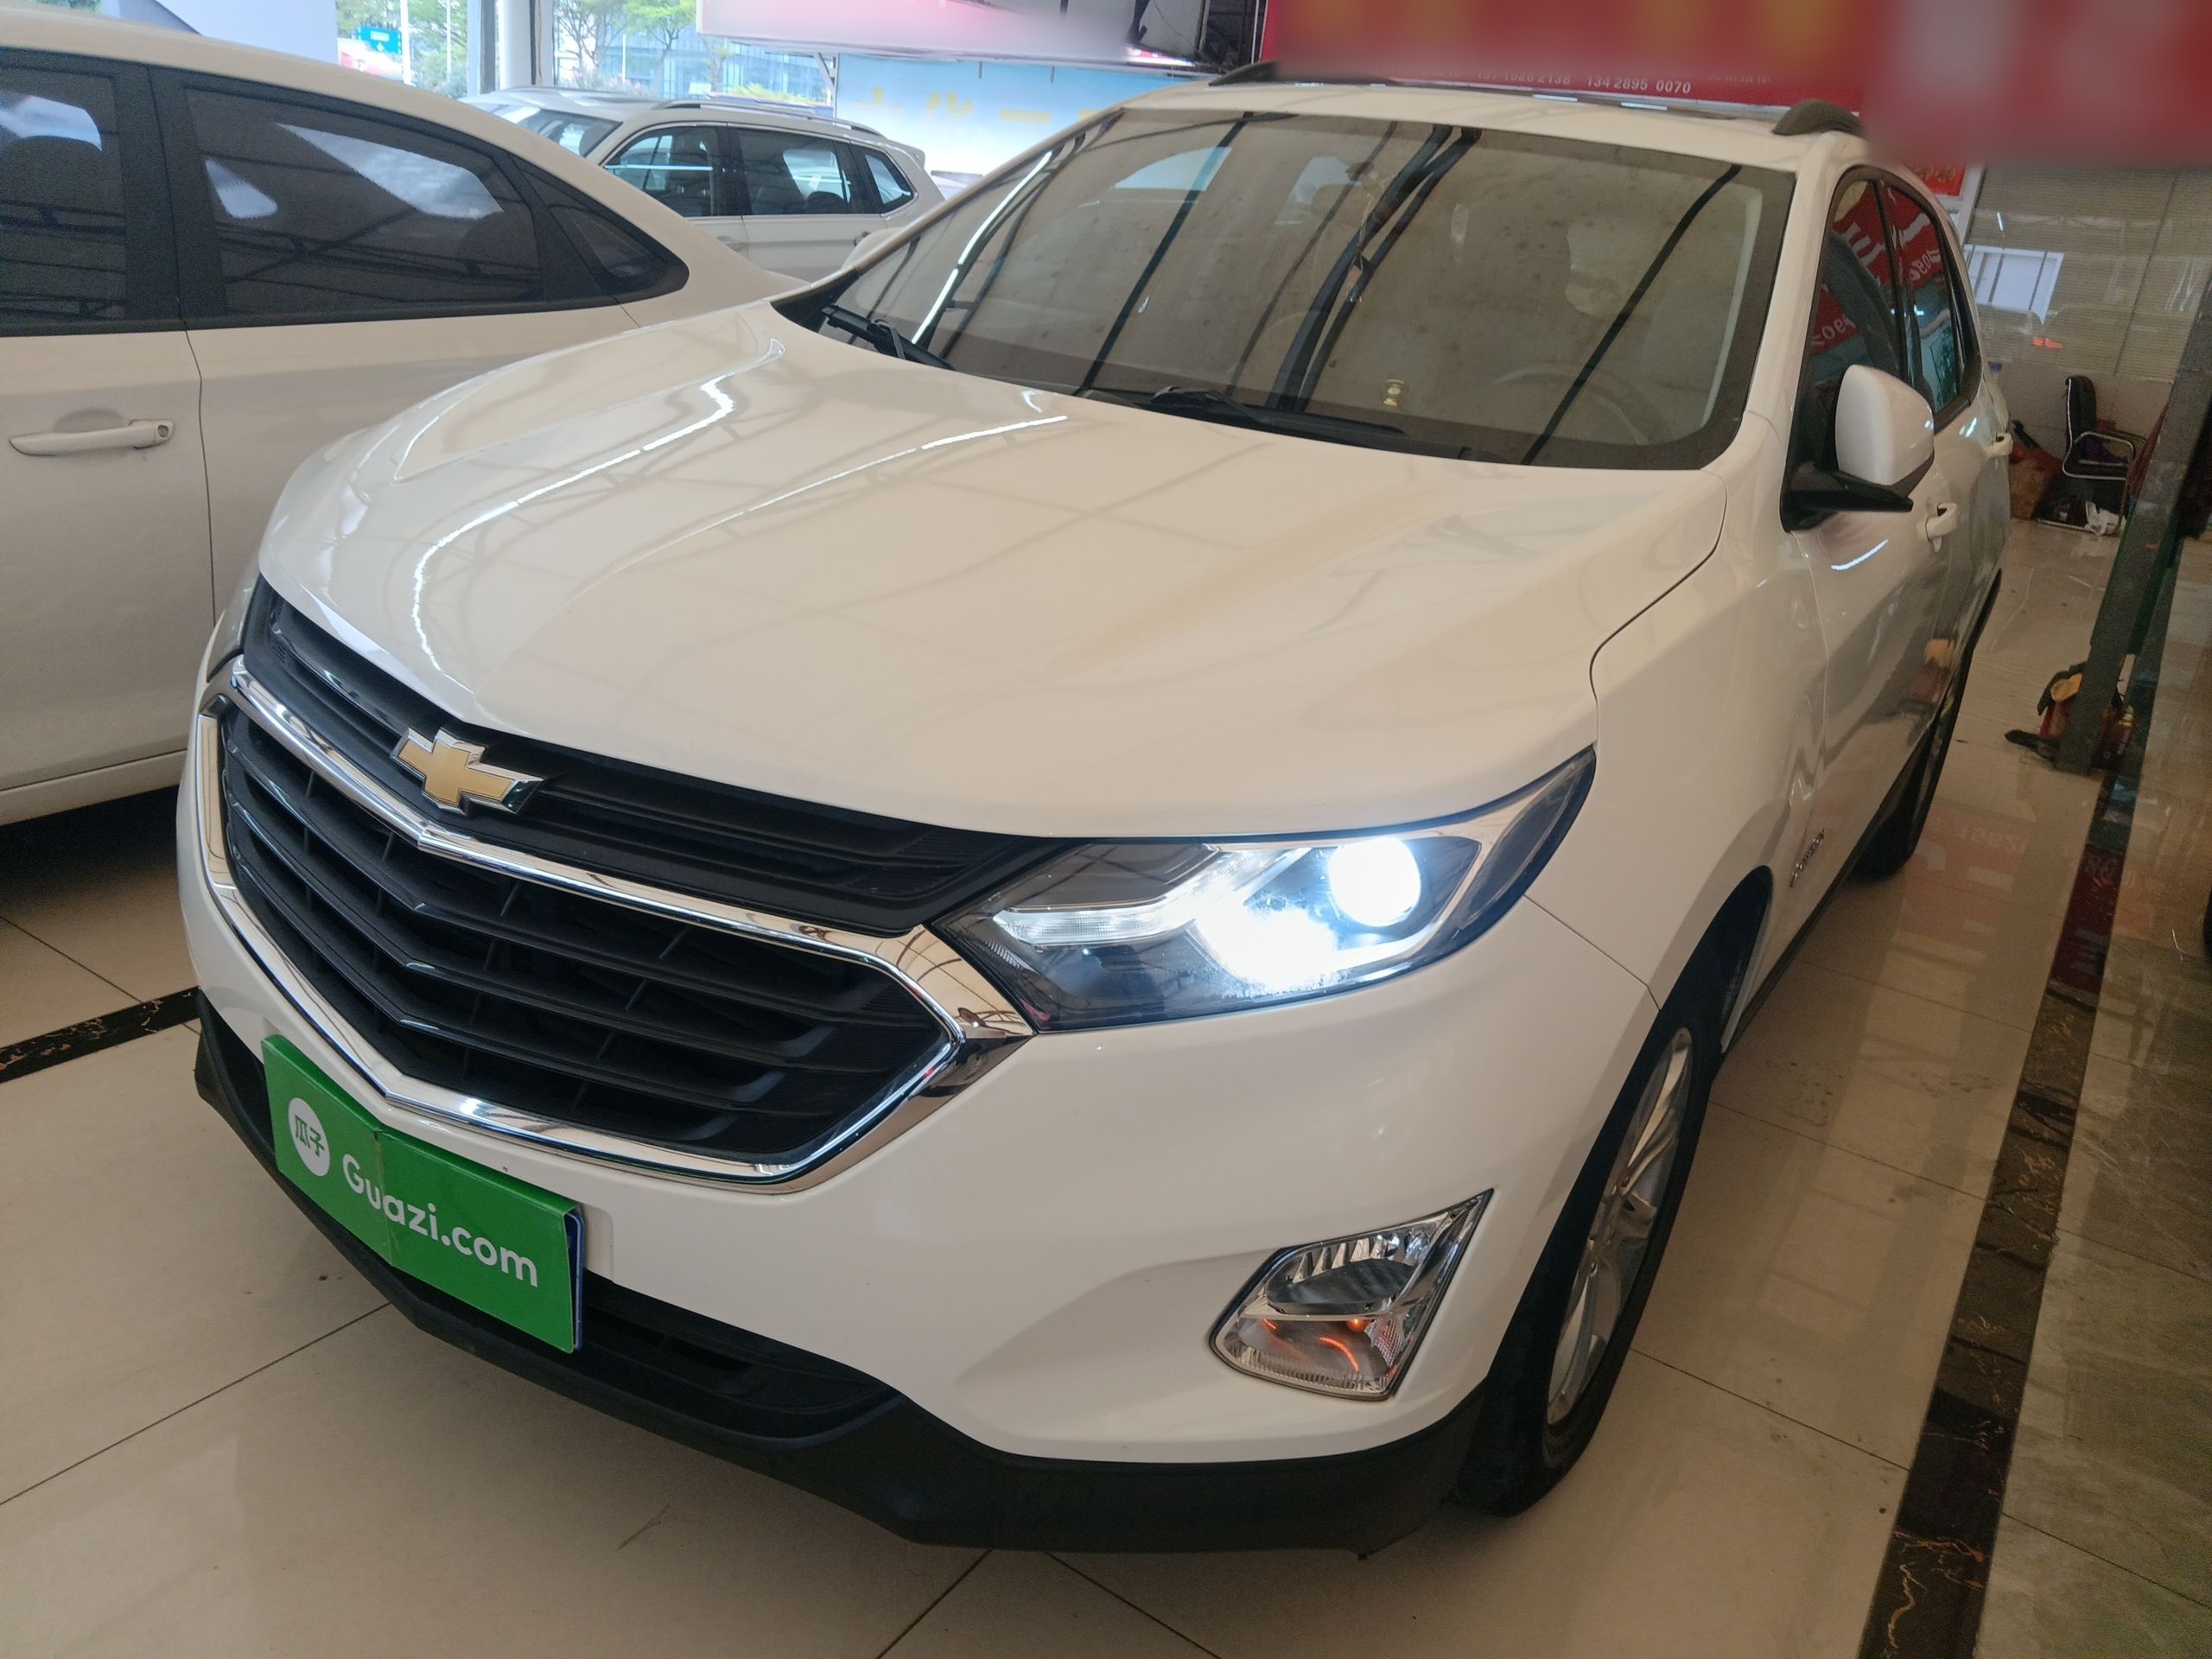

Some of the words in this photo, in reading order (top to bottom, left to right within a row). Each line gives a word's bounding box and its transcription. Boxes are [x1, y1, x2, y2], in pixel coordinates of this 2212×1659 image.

[1537, 70, 1572, 86] 2138
[1586, 74, 1611, 88] 134
[1613, 76, 1649, 91] 2895
[1656, 79, 1692, 94] 0070
[294, 1114, 326, 1158] 瓜子
[342, 1154, 538, 1287] Guazi.com
